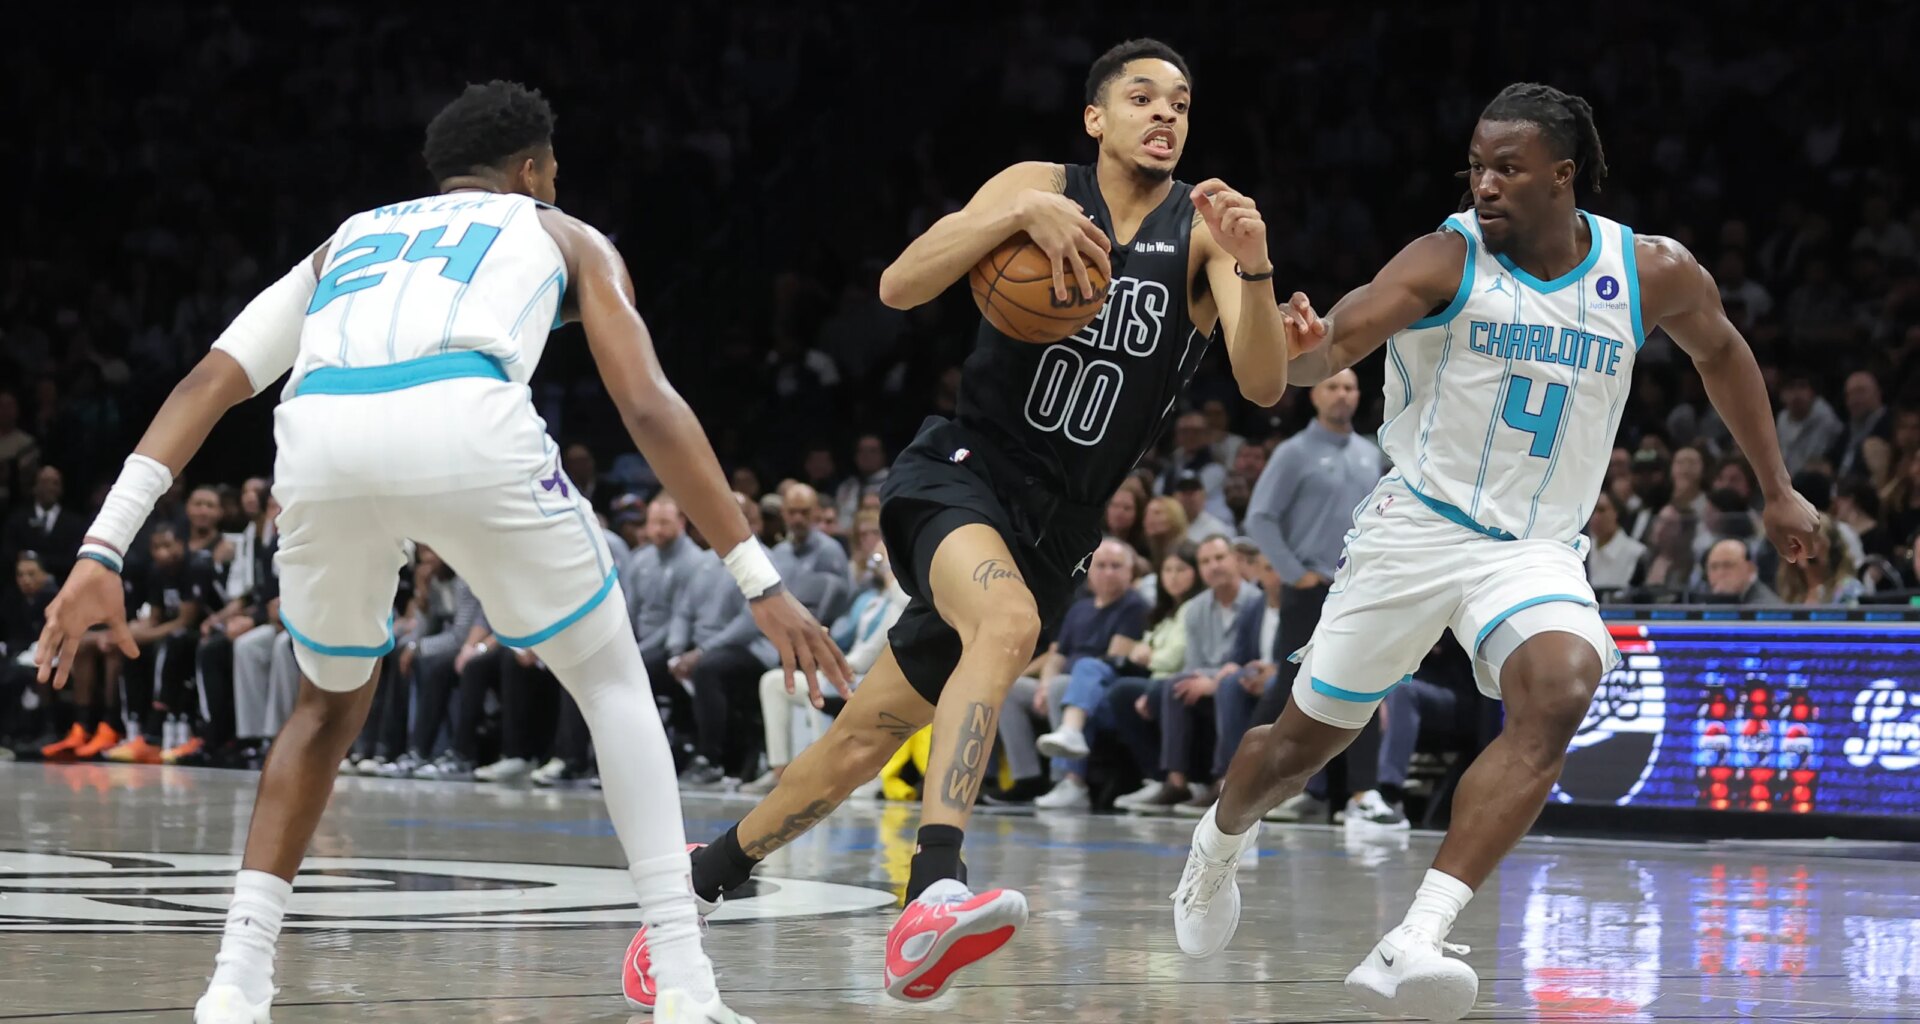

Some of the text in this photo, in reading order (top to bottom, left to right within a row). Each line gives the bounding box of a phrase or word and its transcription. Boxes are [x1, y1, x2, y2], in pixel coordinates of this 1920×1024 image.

[306, 222, 500, 316] 24
[1134, 241, 1174, 253] All In Won
[1606, 301, 1628, 310] Health
[1469, 321, 1623, 376] CHARLOTTE
[1024, 344, 1124, 446] 00
[1501, 374, 1569, 458] 4
[947, 702, 992, 807] NOW
